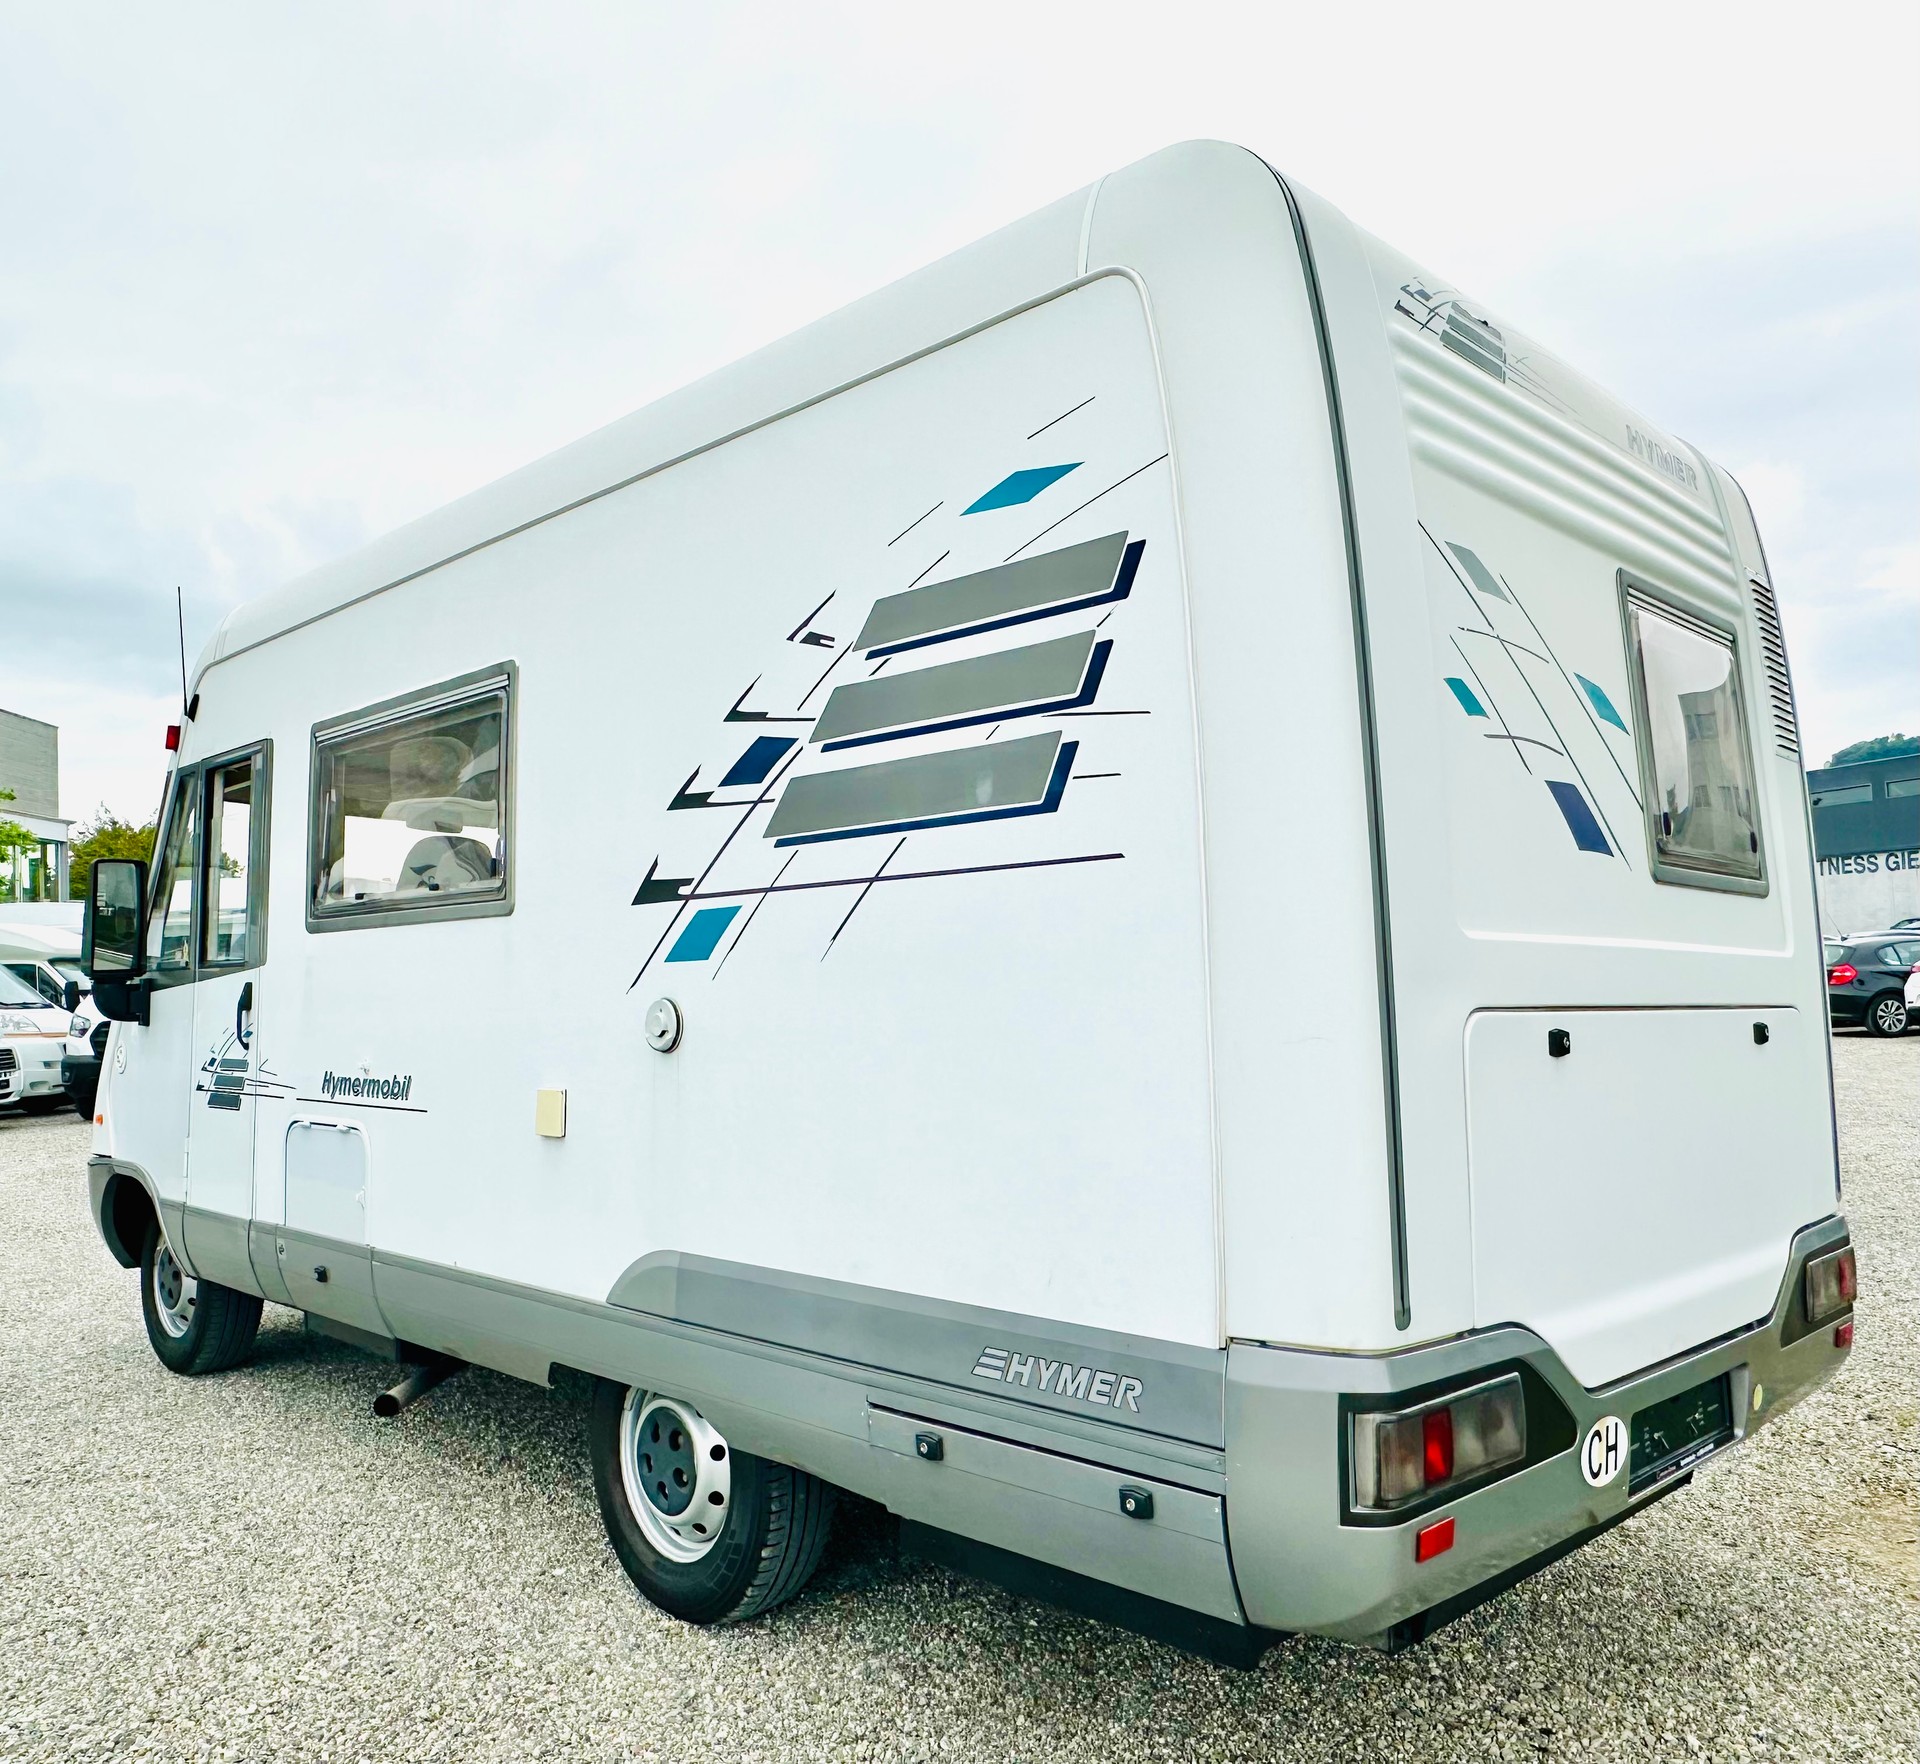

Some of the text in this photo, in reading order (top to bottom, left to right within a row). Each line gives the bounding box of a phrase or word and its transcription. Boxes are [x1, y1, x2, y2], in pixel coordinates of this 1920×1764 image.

[1625, 424, 1698, 491] HYMER
[1816, 854, 1879, 876] TNESS
[321, 1070, 412, 1101] Hymermobil
[1005, 1352, 1143, 1413] HYMER
[1588, 1421, 1618, 1480] CH
